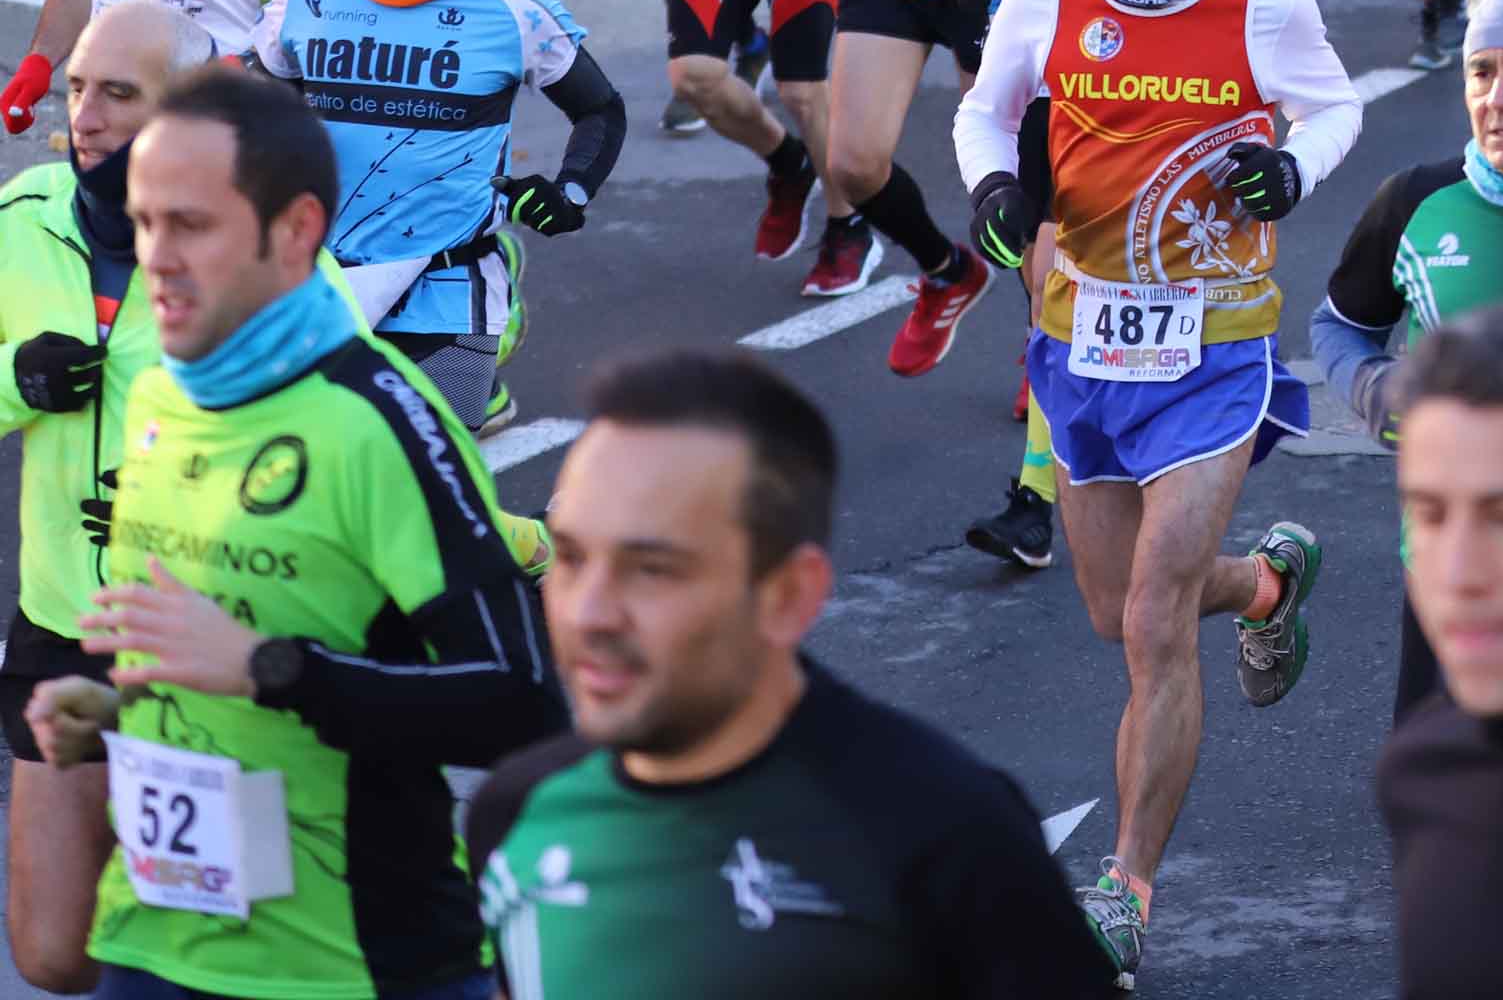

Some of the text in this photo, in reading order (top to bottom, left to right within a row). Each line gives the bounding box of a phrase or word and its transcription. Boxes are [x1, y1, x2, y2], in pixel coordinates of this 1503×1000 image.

[323, 9, 377, 27] running
[306, 36, 461, 89] naturé
[350, 95, 377, 114] de
[383, 99, 466, 120] estética
[1060, 72, 1241, 106] VILLORUELA
[1135, 185, 1161, 257] ATLETISMO
[1160, 161, 1183, 185] LAS
[1187, 121, 1257, 160] MIMBRERAS
[1094, 303, 1174, 345] 487
[1079, 344, 1190, 367] JOMISAGA
[140, 785, 197, 856] 52
